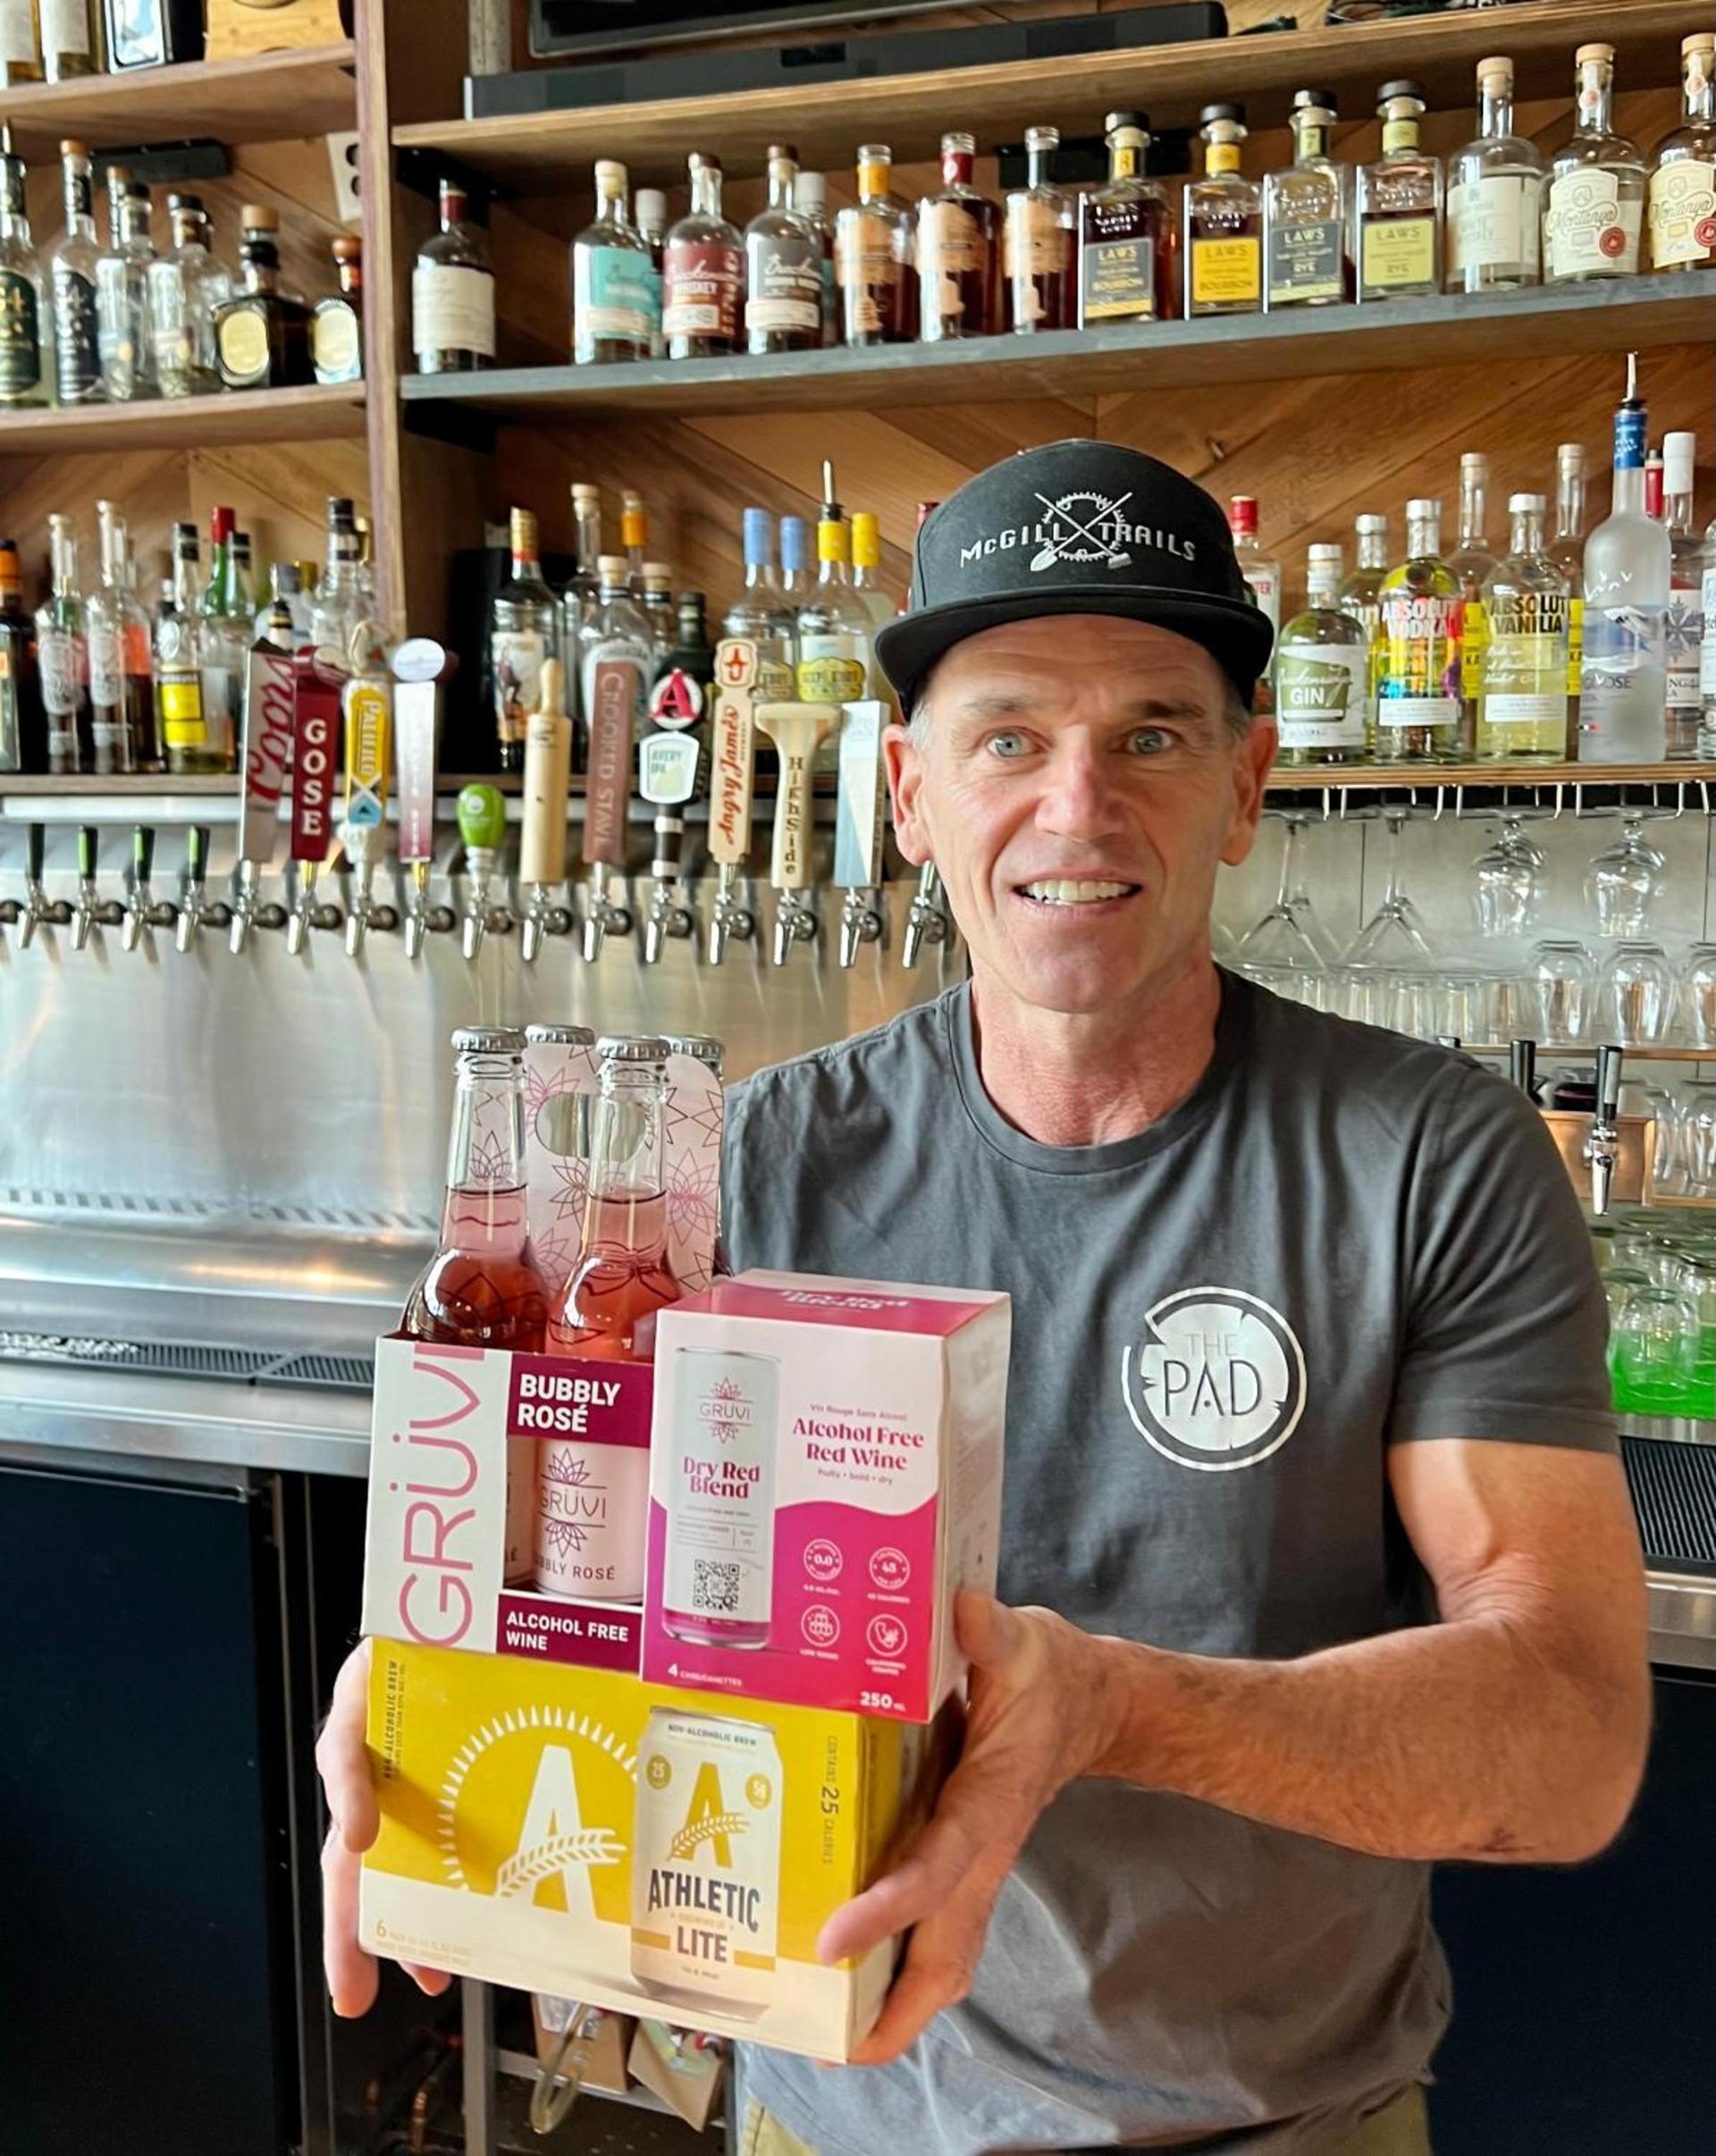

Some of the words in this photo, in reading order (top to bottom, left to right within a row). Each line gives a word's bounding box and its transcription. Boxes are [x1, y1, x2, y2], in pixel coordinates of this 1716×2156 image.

[1284, 227, 1325, 244] LAWS
[1376, 226, 1421, 240] LAWS
[1098, 245, 1138, 261] LAWS
[1205, 244, 1249, 258] LAWS
[1097, 521, 1196, 562] TRAILS
[1382, 597, 1459, 621] ABSOLUT
[1491, 594, 1568, 616] ABSOLUT
[1291, 686, 1325, 705] GIN
[600, 672, 625, 779] CROOKED
[652, 749, 683, 762] AVERY
[301, 718, 329, 836] GOSE
[717, 774, 743, 846] Angry
[1184, 1332, 1239, 1357] THE
[518, 1373, 621, 1407] BUBBLY
[1164, 1359, 1262, 1417] PAD
[517, 1402, 589, 1434] ROSÉ
[793, 1417, 872, 1443] Alcohol
[877, 1426, 925, 1448] Free
[806, 1442, 846, 1463] Red
[851, 1447, 908, 1470] Wine
[684, 1456, 719, 1478] Dry
[722, 1461, 760, 1483] Red
[390, 1342, 485, 1646] GRÜVI
[690, 1475, 750, 1499] Blend
[572, 1566, 616, 1581] ROSÉ
[505, 1611, 584, 1637] ALCOHOL
[587, 1622, 629, 1643] FREE
[506, 1630, 548, 1650] WINE
[668, 1663, 678, 1678] 4
[860, 1691, 893, 1709] 250
[668, 1724, 732, 1742] NON-ALCOHOLIC
[734, 1734, 757, 1747] BREW
[820, 1786, 840, 1815] 25
[648, 1868, 761, 1933] ATHLETIC
[376, 1919, 387, 1938] 6
[677, 1925, 728, 1963] LITE
